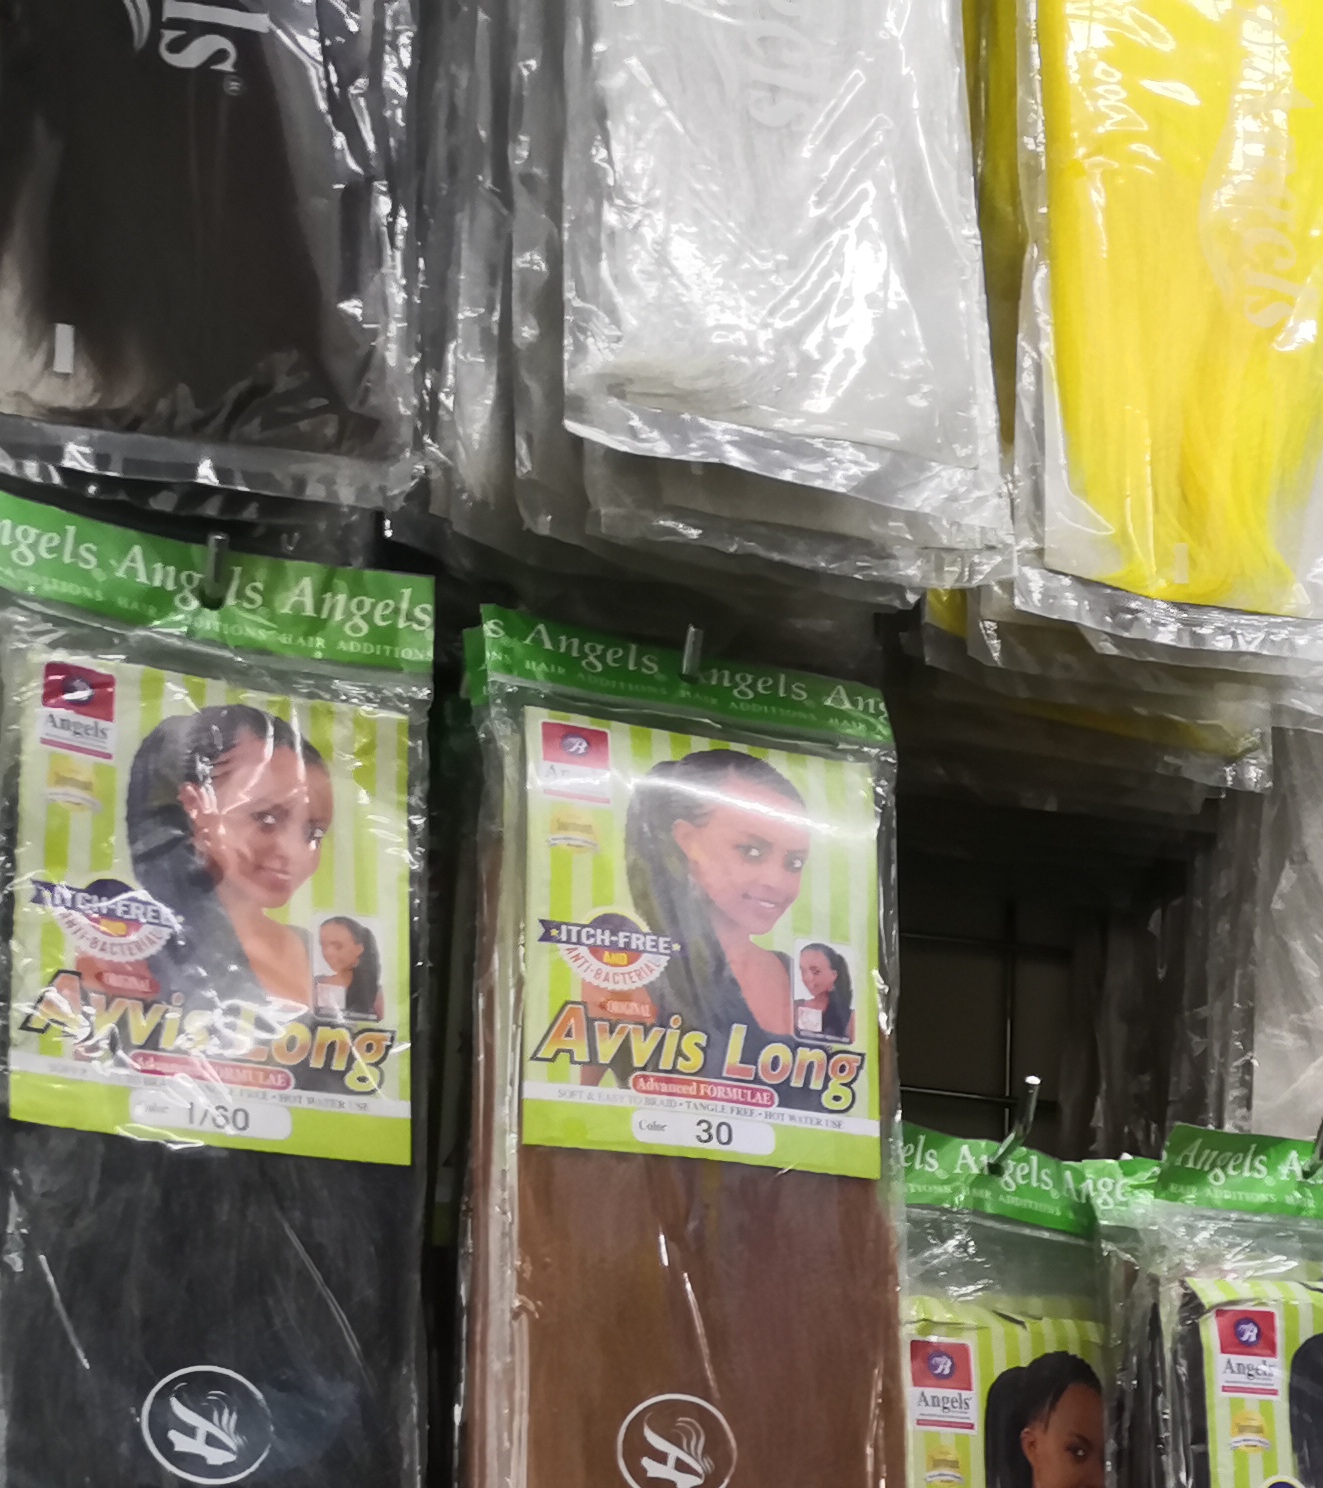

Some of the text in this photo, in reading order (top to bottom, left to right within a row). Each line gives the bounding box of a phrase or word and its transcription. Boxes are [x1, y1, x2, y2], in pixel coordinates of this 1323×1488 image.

[280, 576, 434, 637] Angels
[524, 622, 660, 676] Angels
[44, 708, 110, 742] Angels
[560, 923, 672, 956] ITCH-FREE
[530, 1000, 867, 1114] Avvis Long
[636, 1076, 773, 1107] Advanced FORMULAE
[184, 1100, 251, 1135] 1/60
[694, 1119, 734, 1146] 30
[1175, 1139, 1268, 1187] Angels
[916, 1390, 972, 1414] Angels
